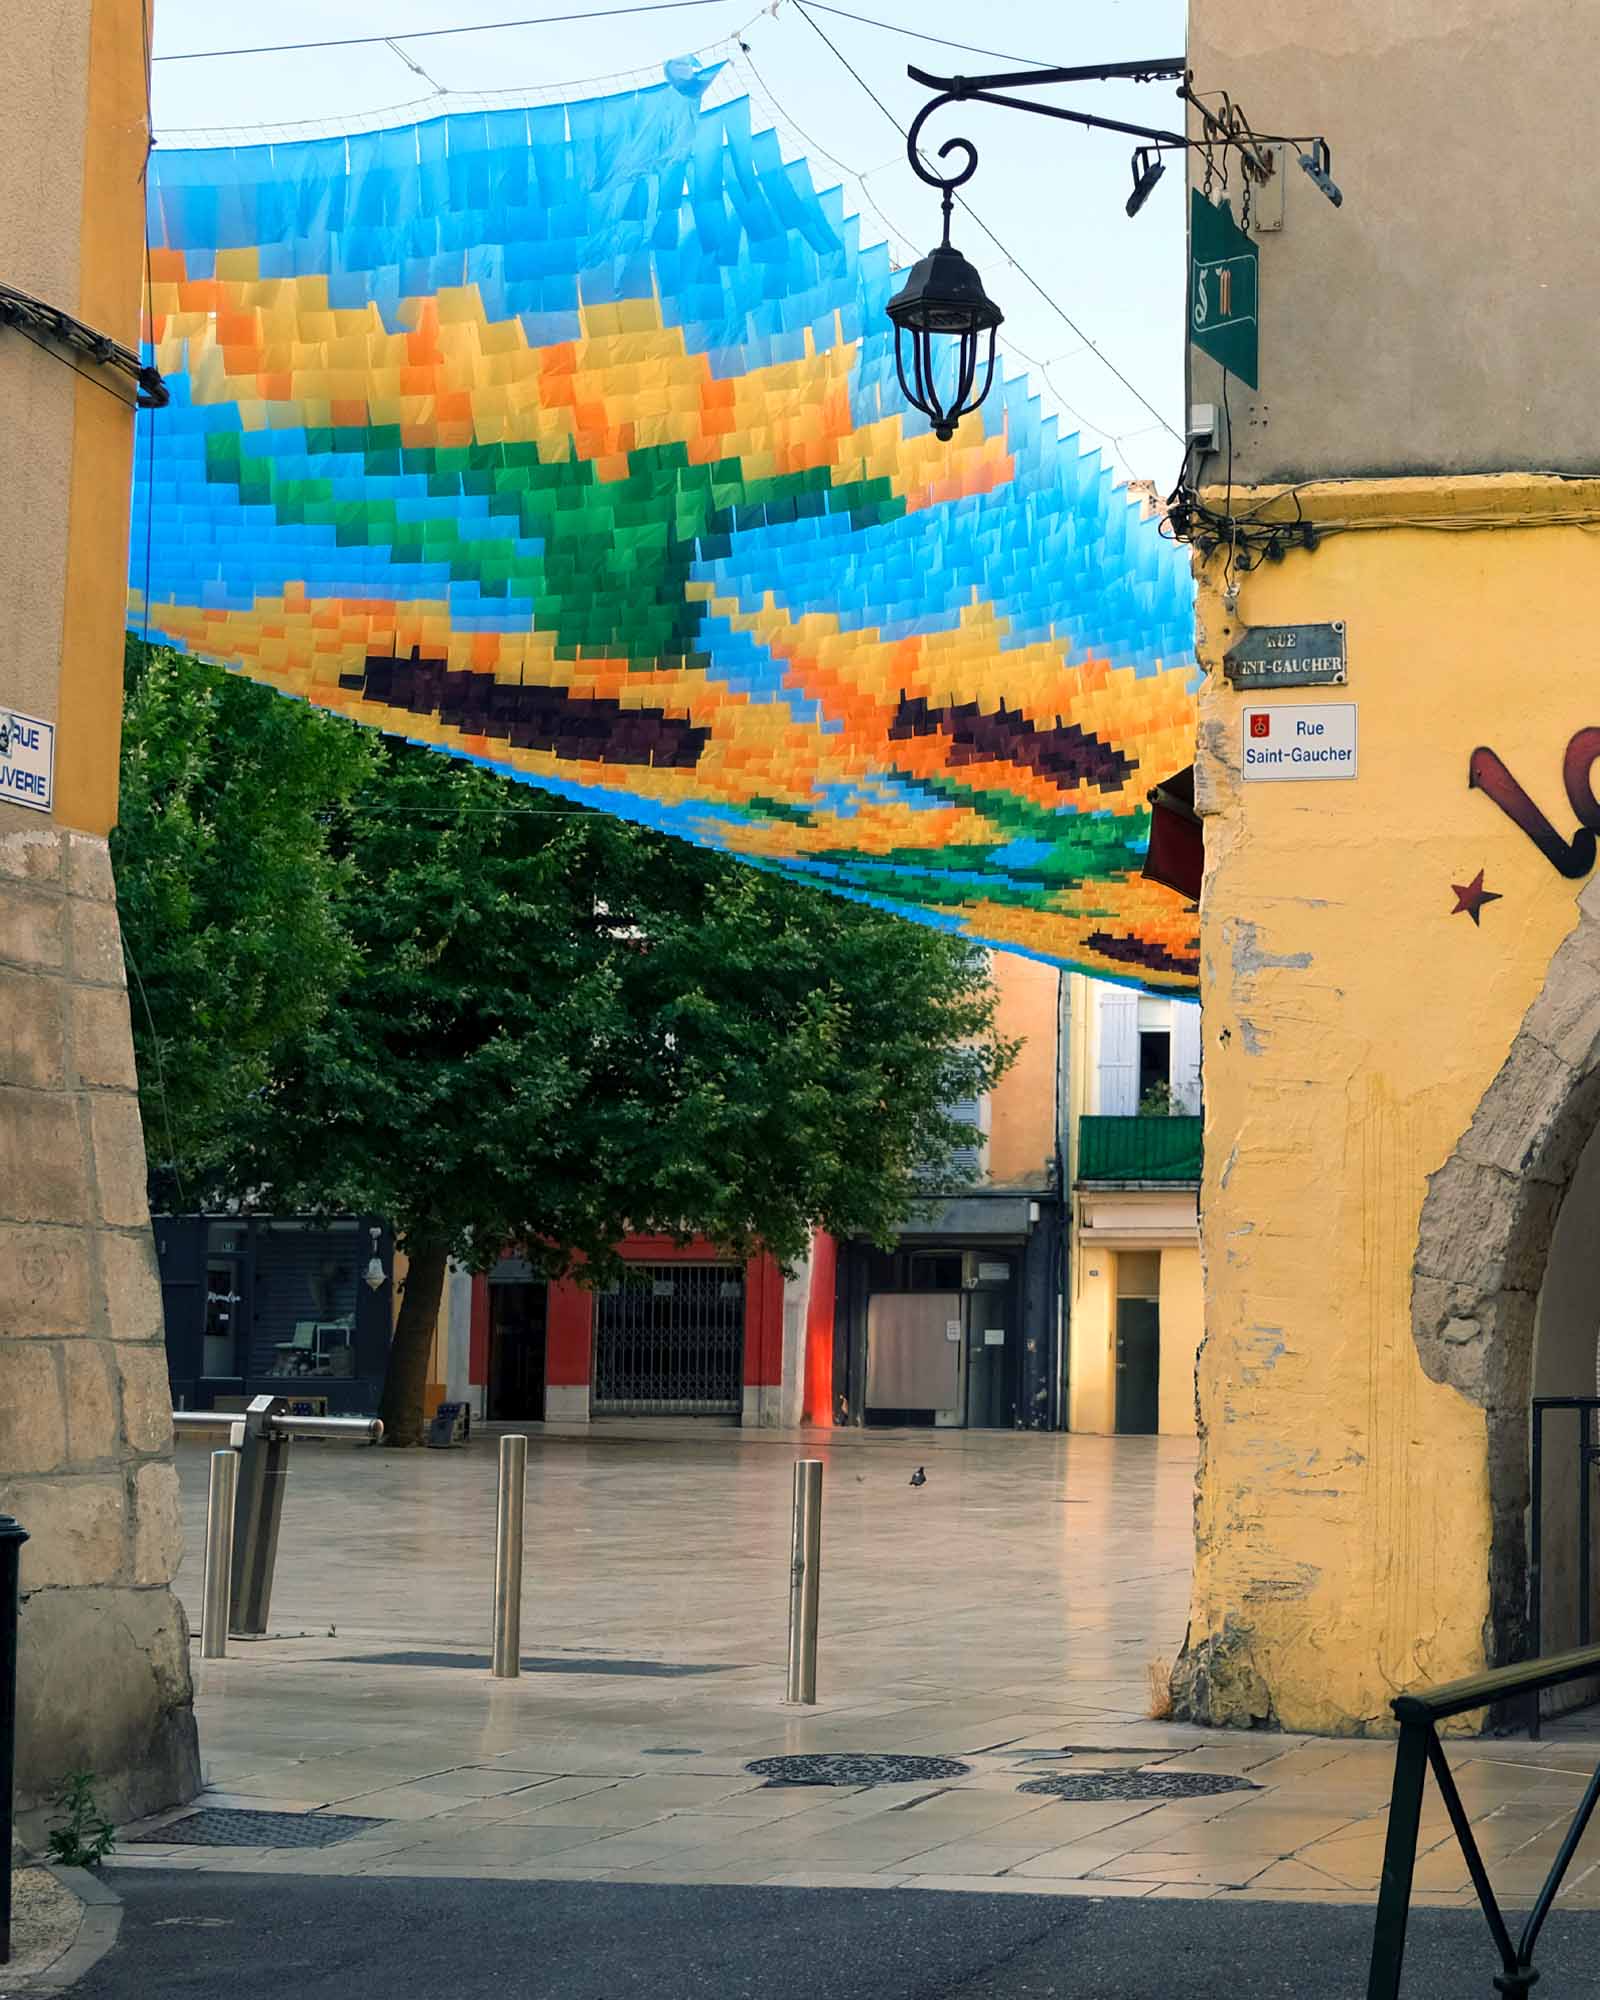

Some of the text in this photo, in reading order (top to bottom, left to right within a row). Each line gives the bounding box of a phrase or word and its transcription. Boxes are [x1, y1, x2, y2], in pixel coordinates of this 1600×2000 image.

[1266, 632, 1297, 648] RUE
[1296, 720, 1325, 736] Rue
[1246, 746, 1352, 764] Saint-Gaucher
